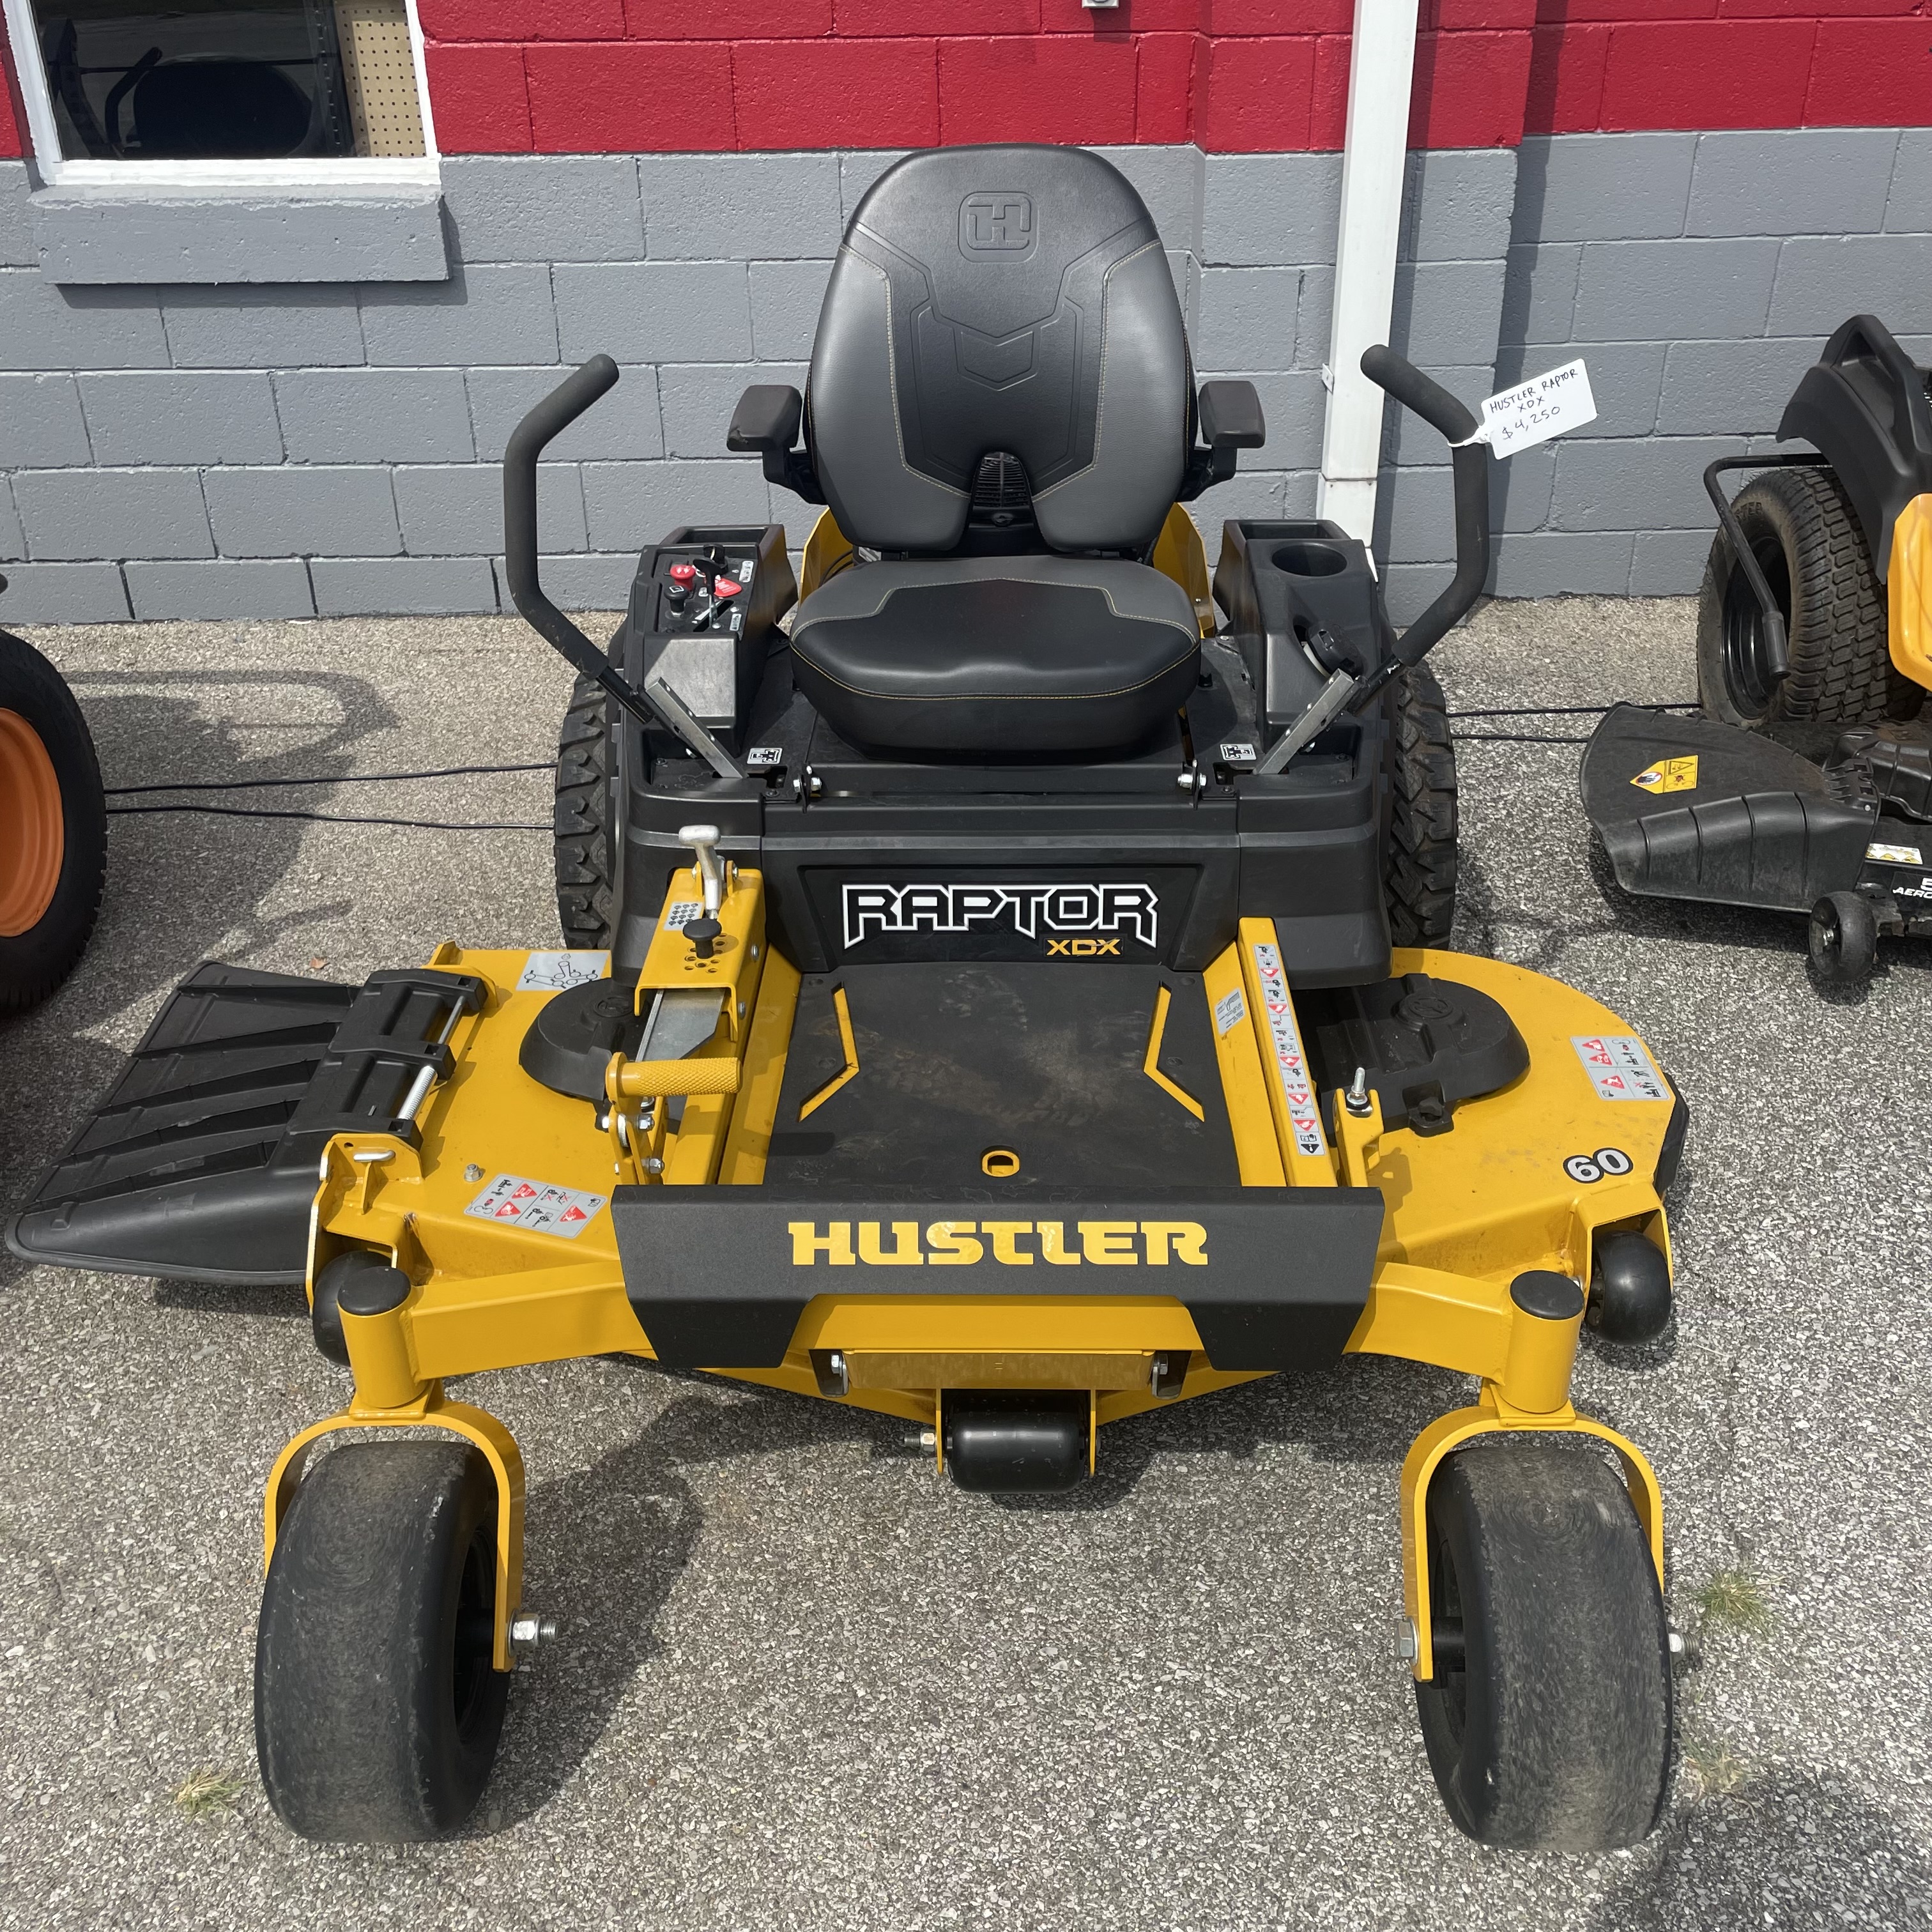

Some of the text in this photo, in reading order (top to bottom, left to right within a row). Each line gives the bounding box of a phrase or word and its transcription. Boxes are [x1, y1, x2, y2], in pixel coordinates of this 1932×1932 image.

[1490, 369, 1578, 413] HUSTLER RAPTOR
[1517, 396, 1545, 412] XDX
[842, 884, 1158, 949] RAPTOR
[1046, 939, 1121, 956] XDX
[1564, 1148, 1633, 1183] 60
[788, 1222, 1208, 1265] HUSTLER
